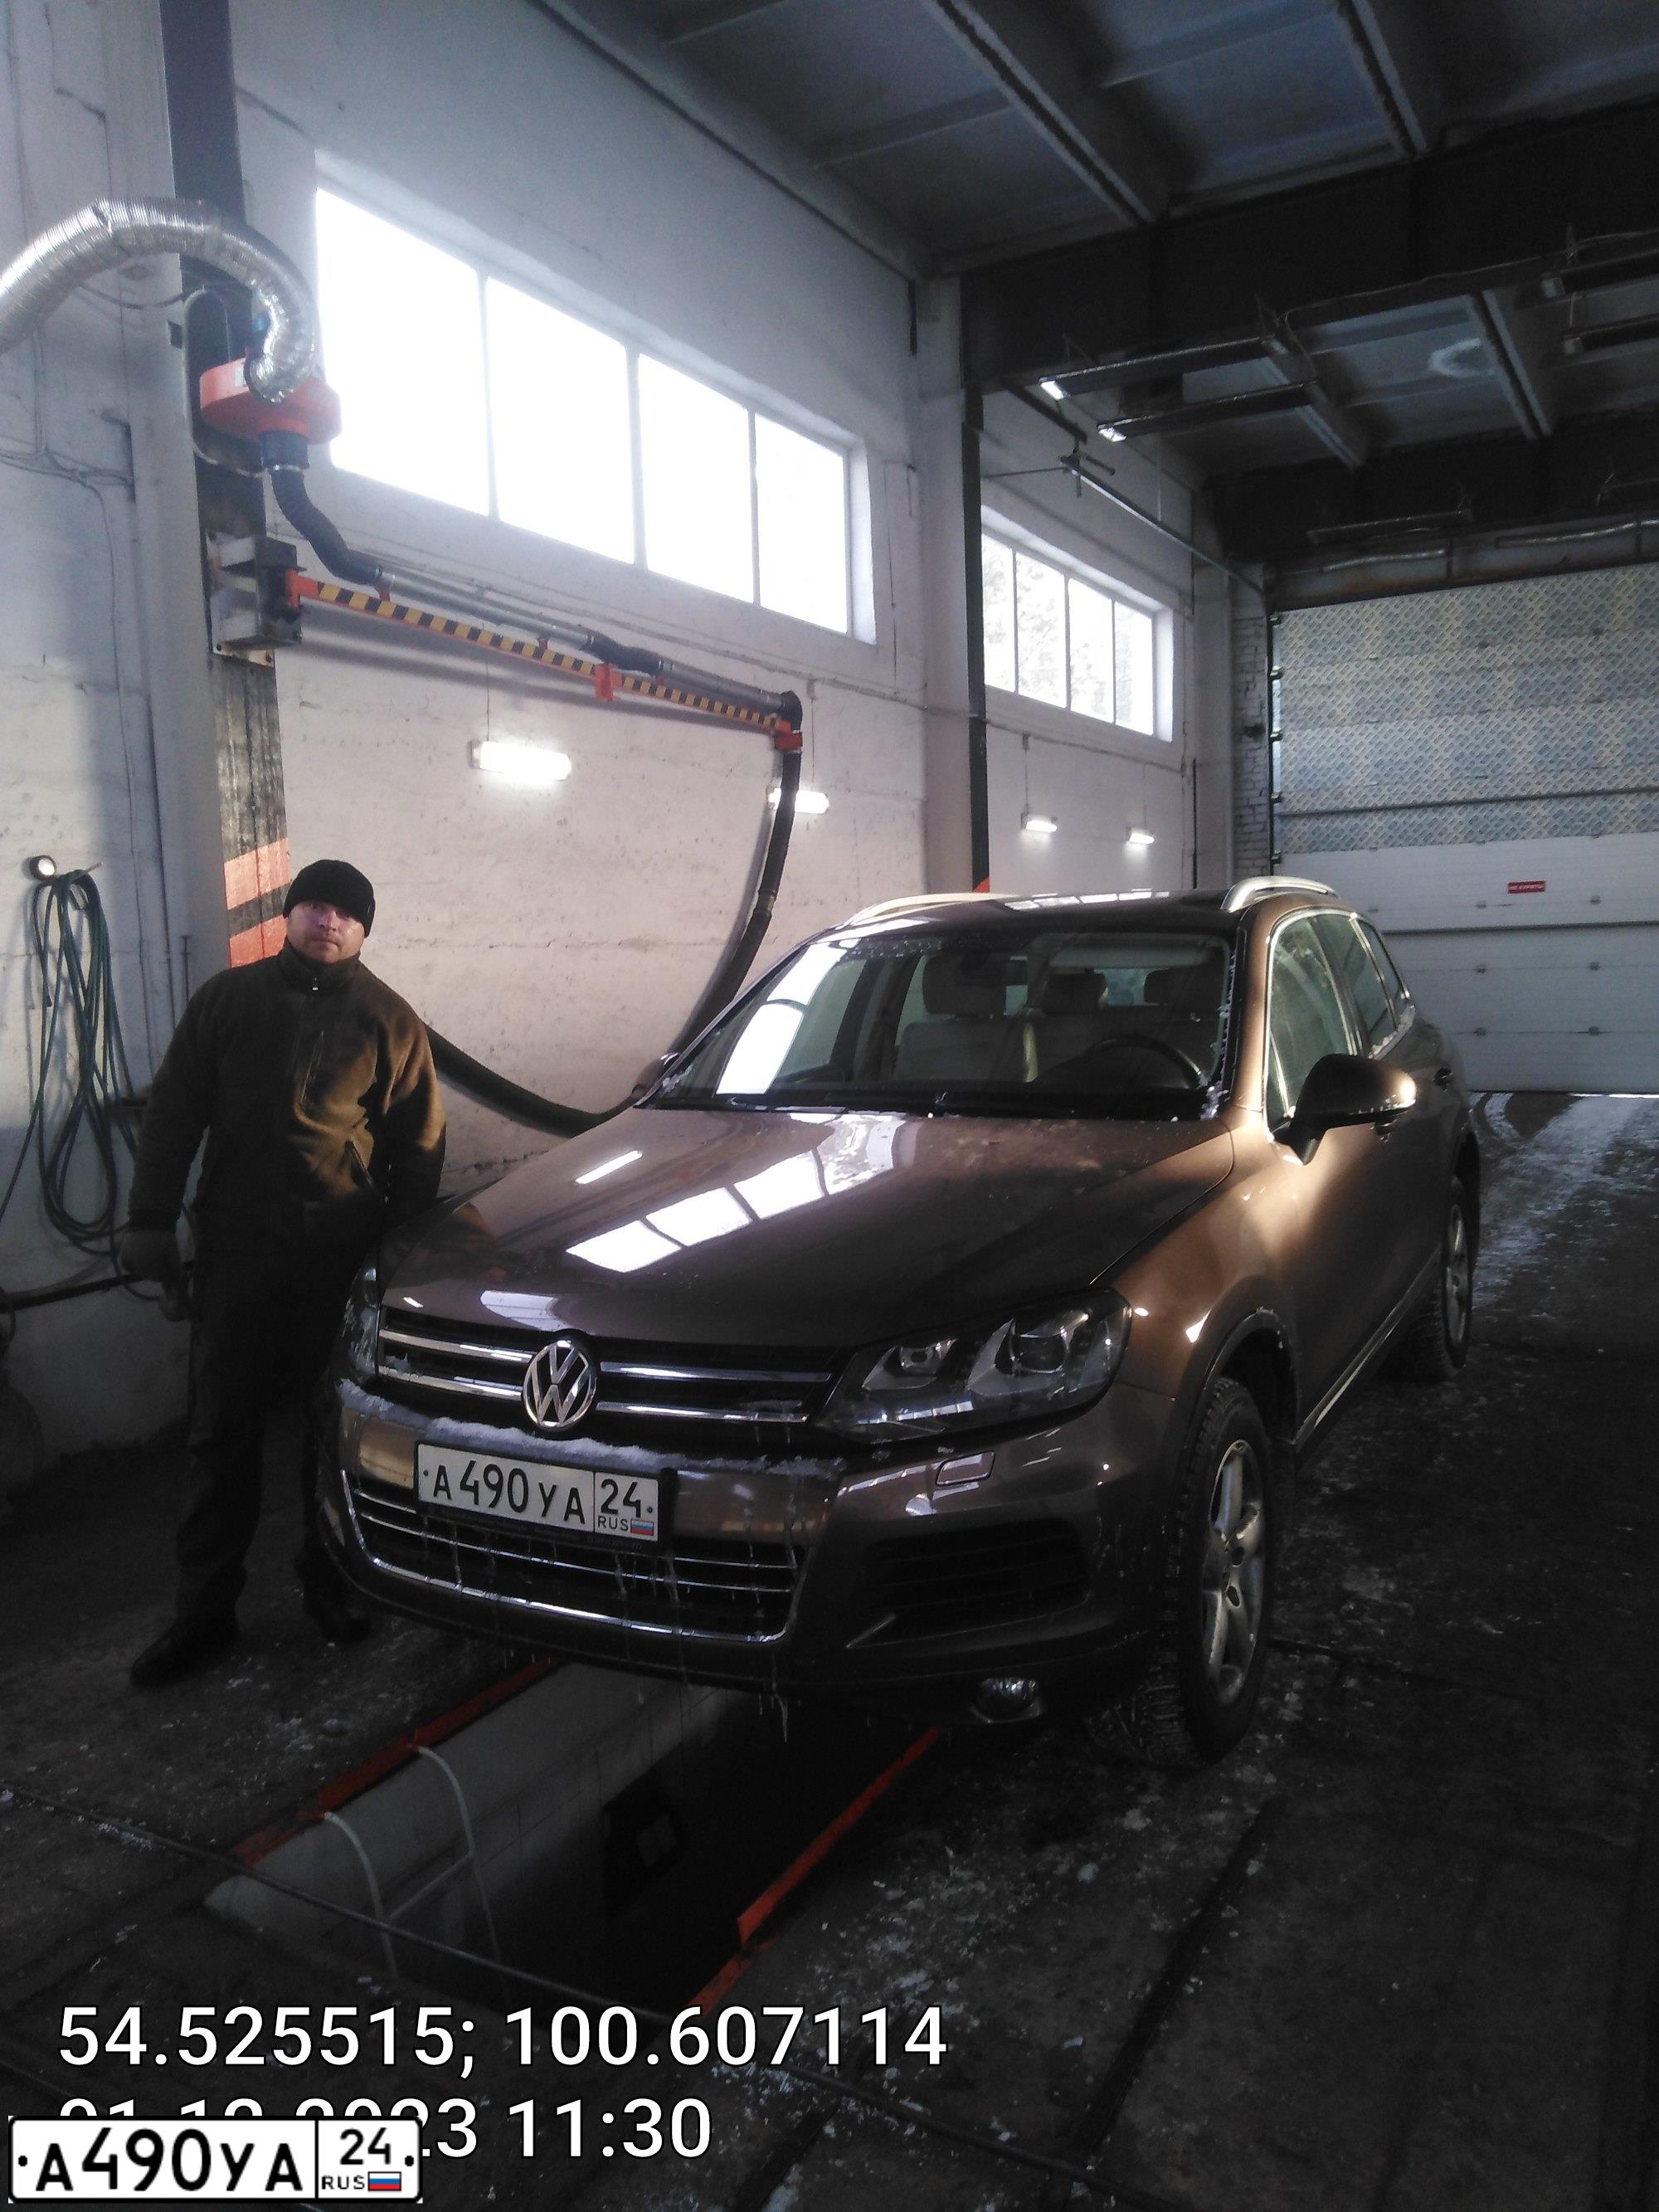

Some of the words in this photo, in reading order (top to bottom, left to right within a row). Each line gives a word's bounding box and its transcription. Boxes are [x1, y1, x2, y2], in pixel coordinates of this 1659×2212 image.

[526, 1341, 593, 1426] VW
[600, 1478, 642, 1518] 24
[597, 1515, 629, 1532] RUS
